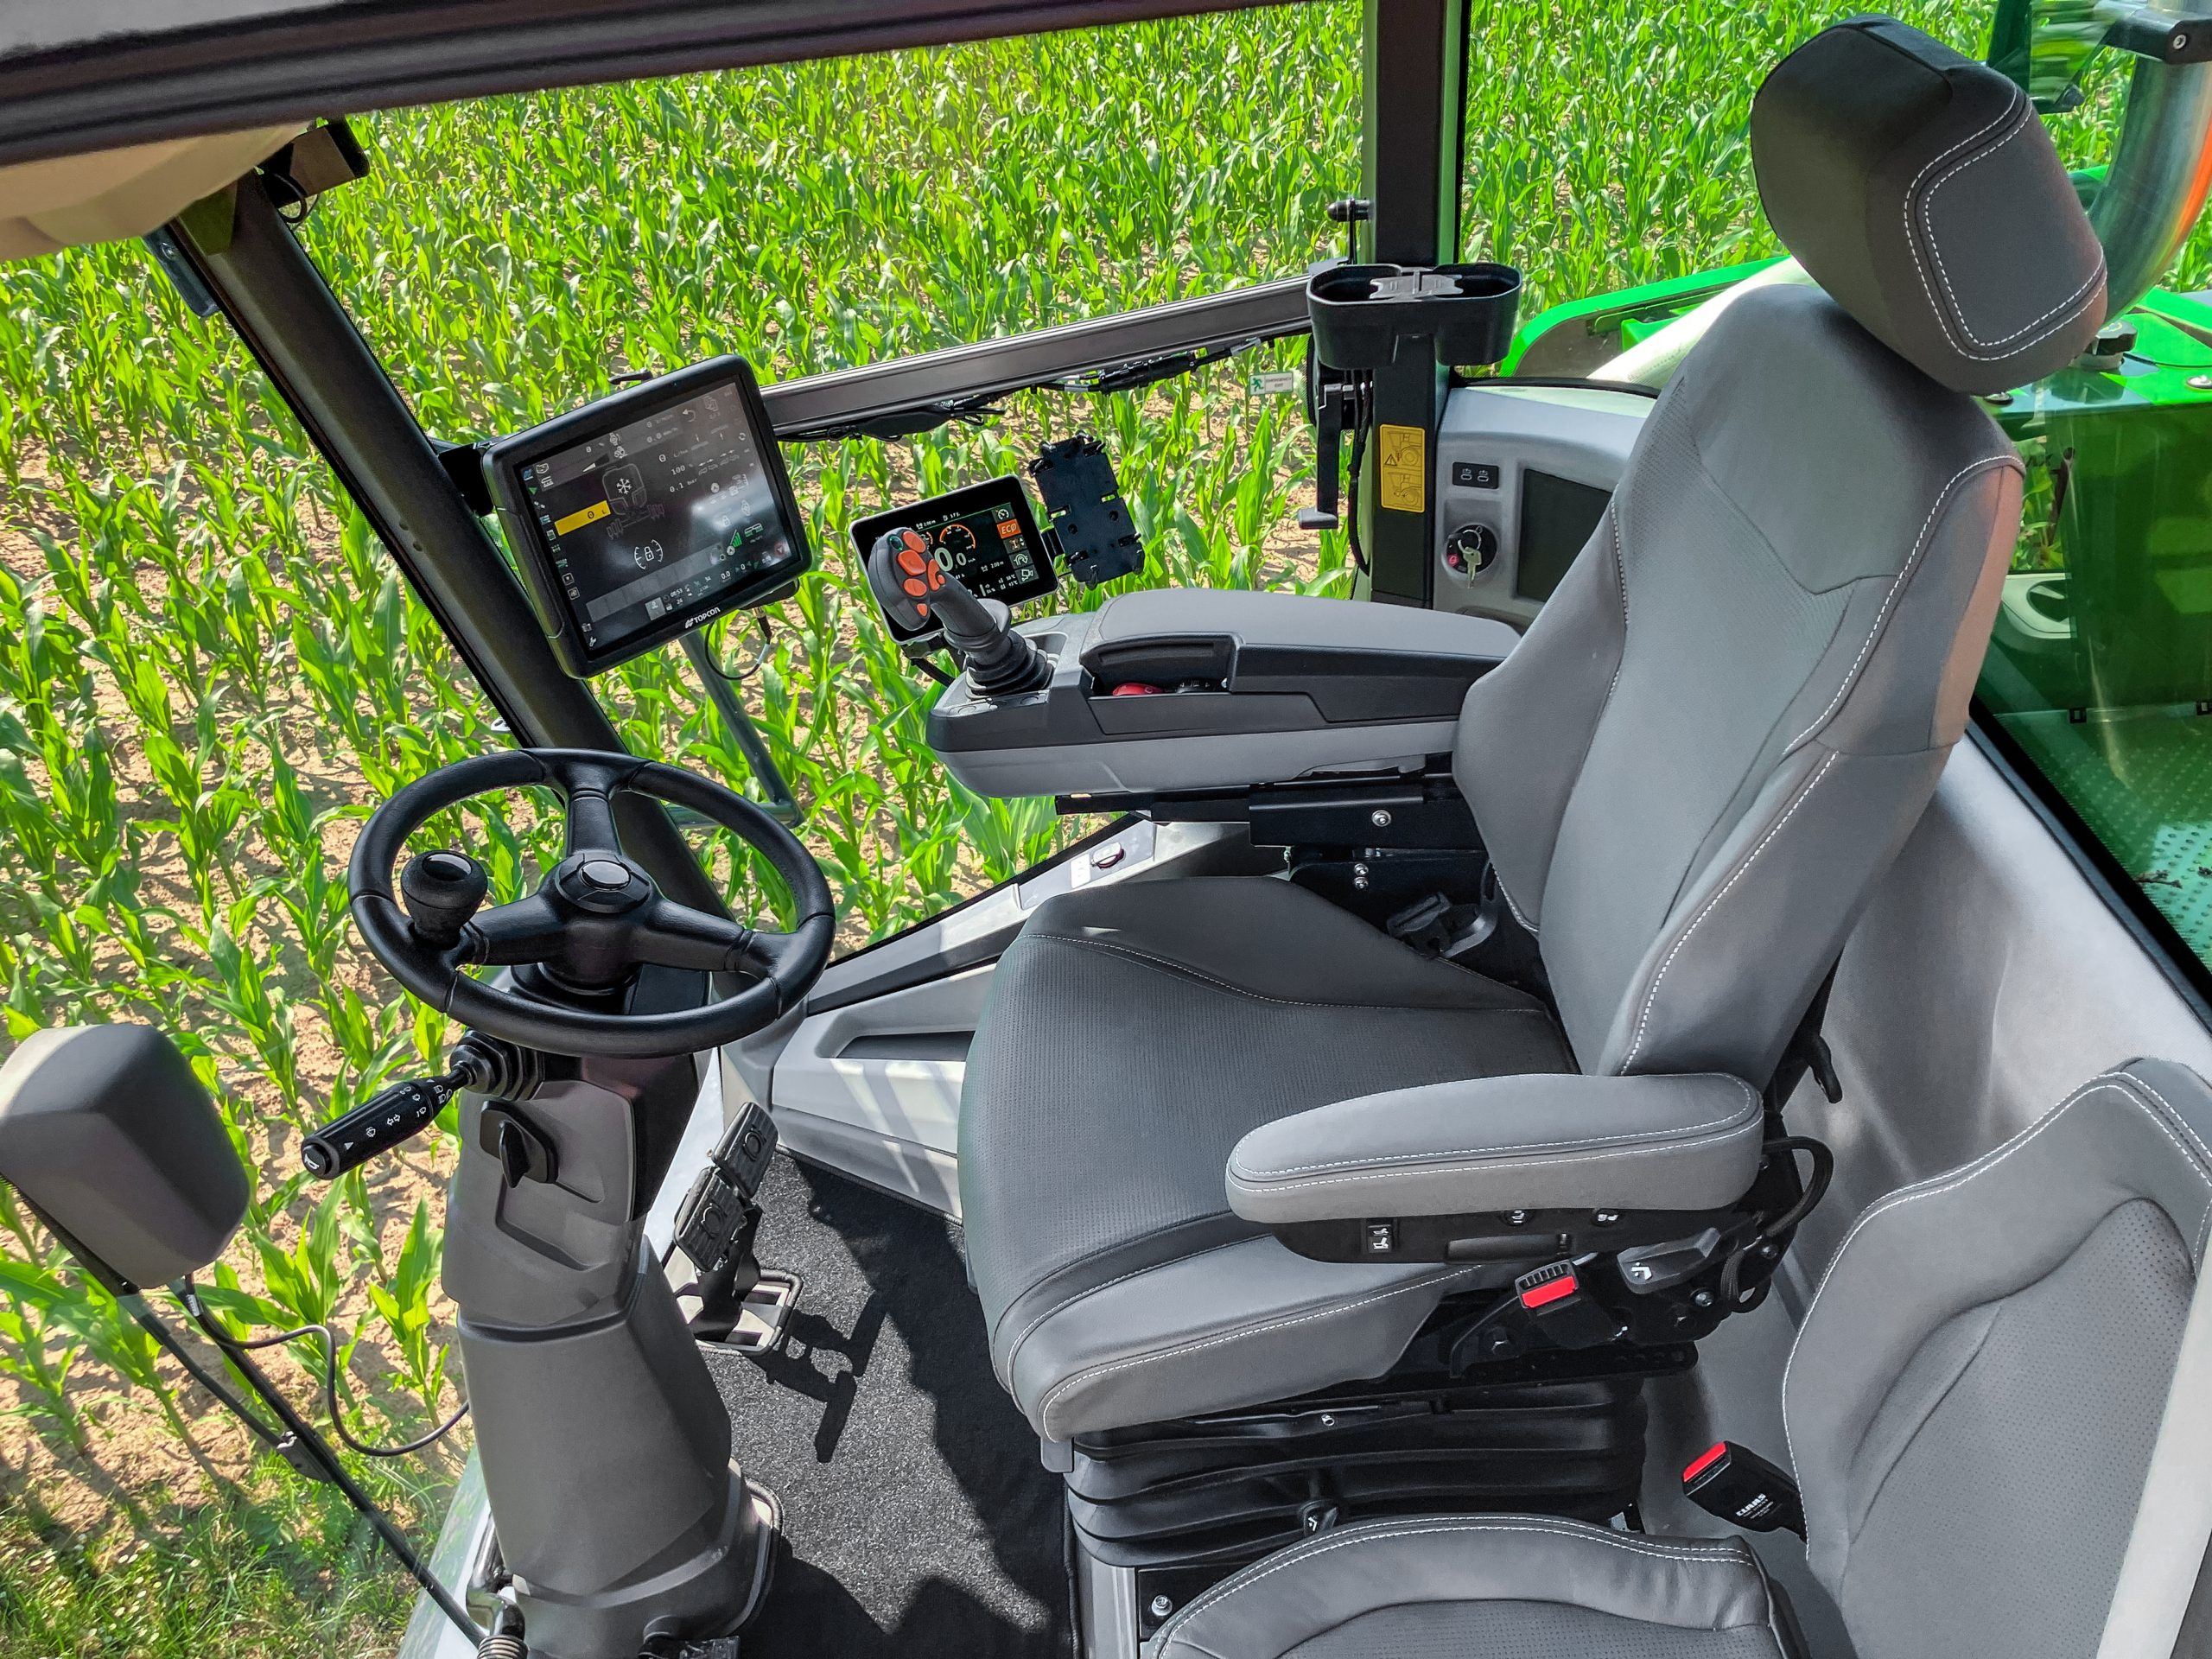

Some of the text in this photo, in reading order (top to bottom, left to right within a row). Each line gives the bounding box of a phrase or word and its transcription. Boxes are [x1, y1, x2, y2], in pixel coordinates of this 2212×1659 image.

[671, 465, 686, 475] 100
[693, 607, 721, 624] TOPCON
[1736, 1493, 1766, 1516] CLAAS
